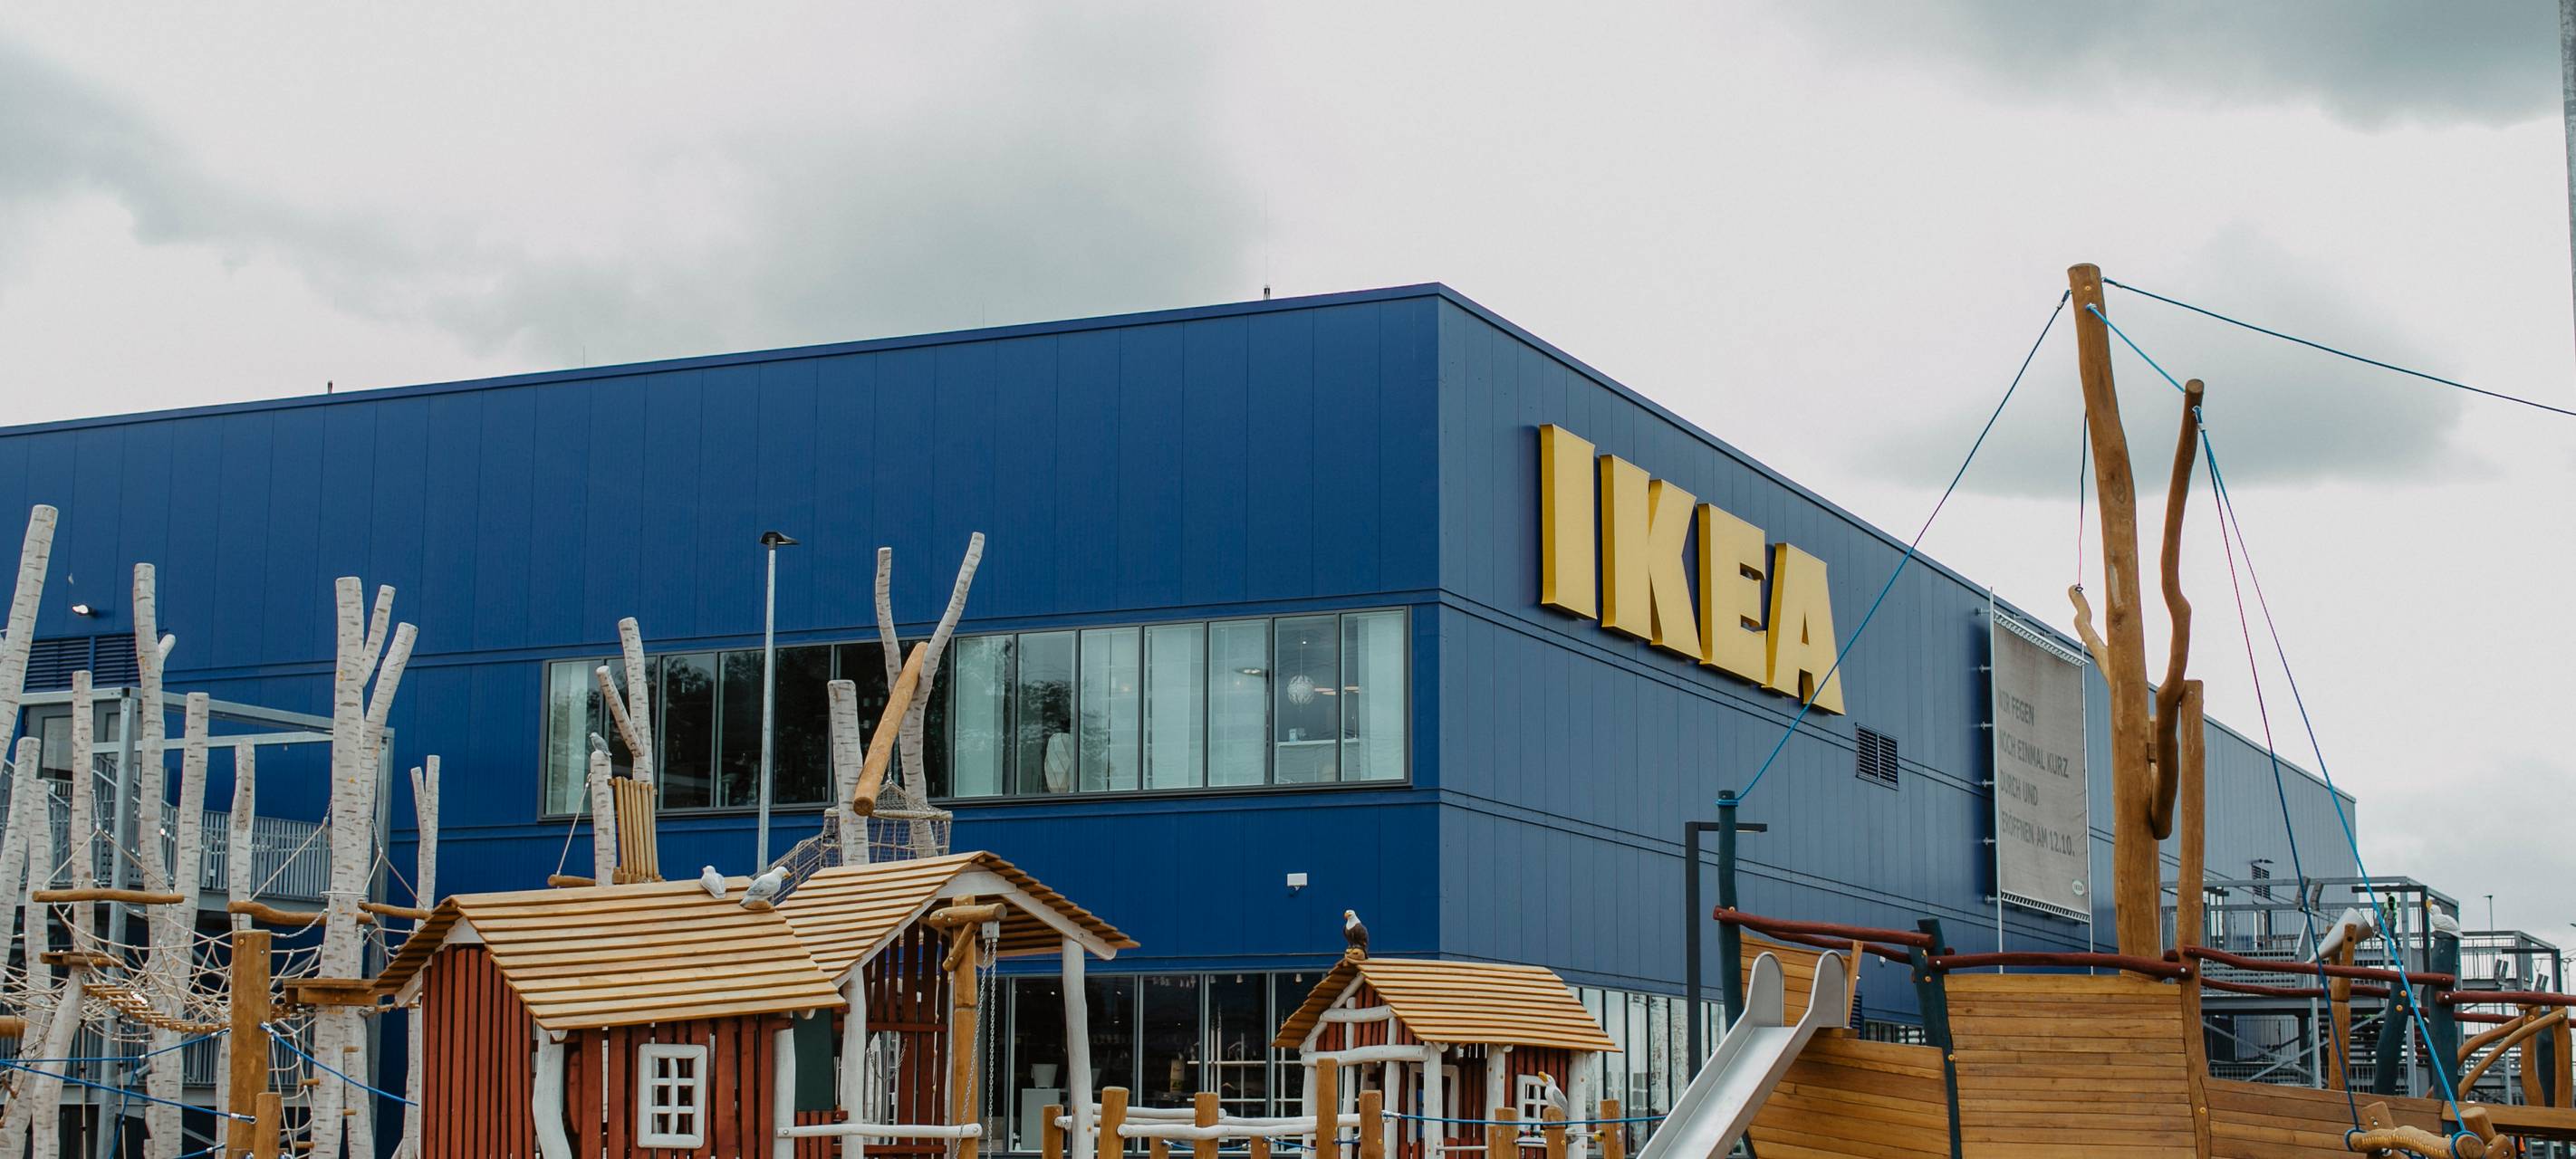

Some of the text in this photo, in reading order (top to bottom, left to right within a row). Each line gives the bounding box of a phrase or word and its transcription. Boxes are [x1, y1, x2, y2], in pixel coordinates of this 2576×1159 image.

[1540, 423, 1846, 716] IKEA
[2012, 695, 2034, 726] FEGEN
[1999, 729, 2069, 778] NOCH EINMAL KURZ
[2000, 770, 2038, 806] DURCH UND
[2002, 809, 2075, 857] ERÖFFNEN AM 12.10.
